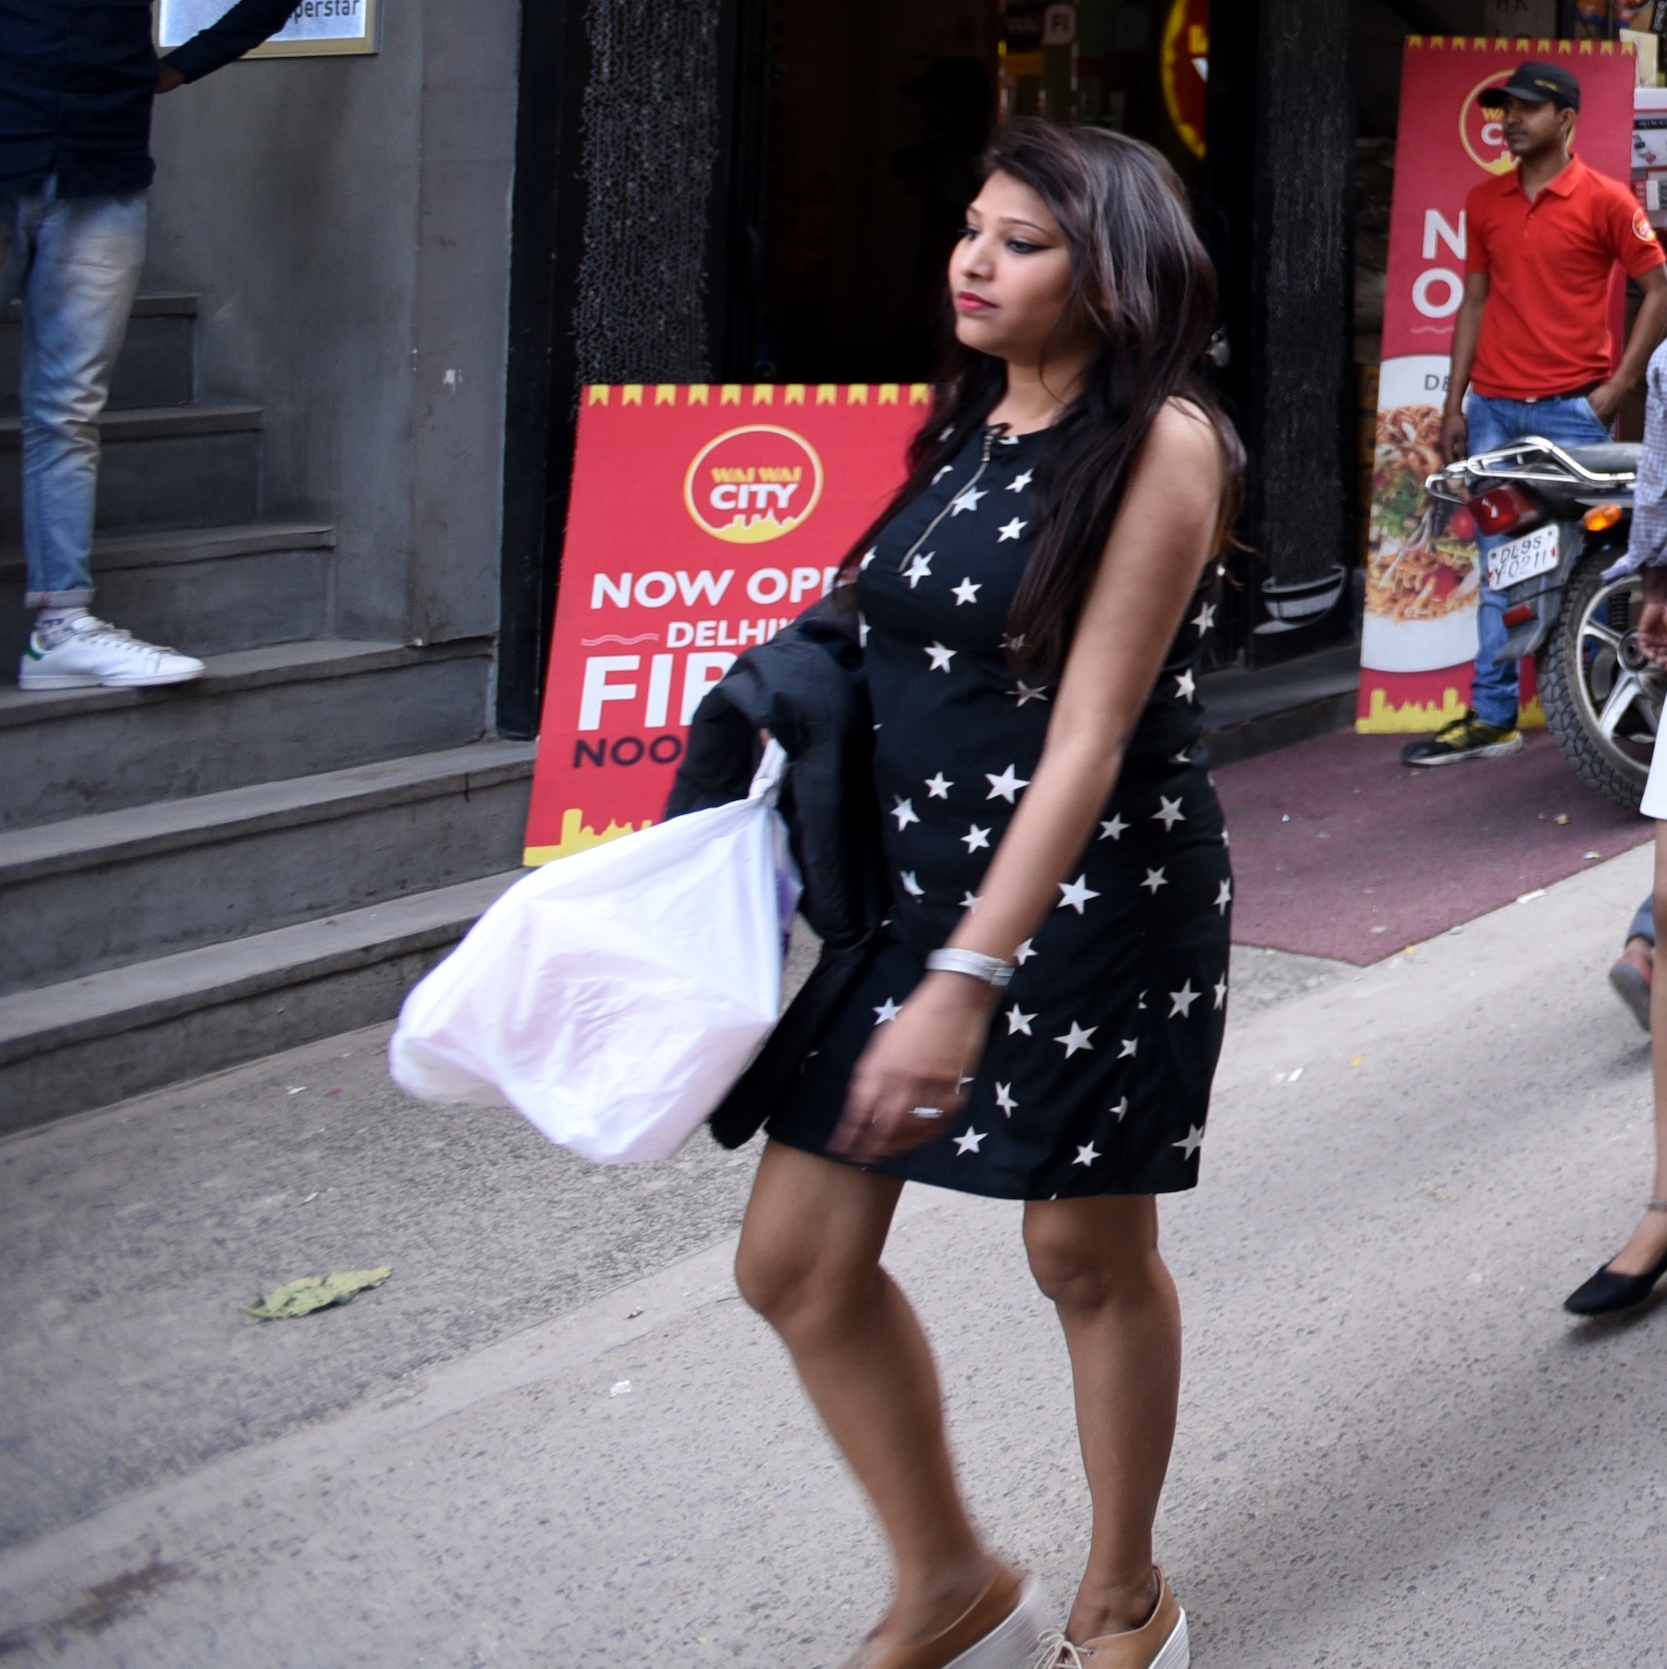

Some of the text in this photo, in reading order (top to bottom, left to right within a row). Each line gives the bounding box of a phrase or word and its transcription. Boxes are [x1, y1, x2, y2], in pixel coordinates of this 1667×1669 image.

[710, 465, 802, 483] WAI WAI
[708, 482, 796, 512] CITY
[590, 569, 734, 612] NOW
